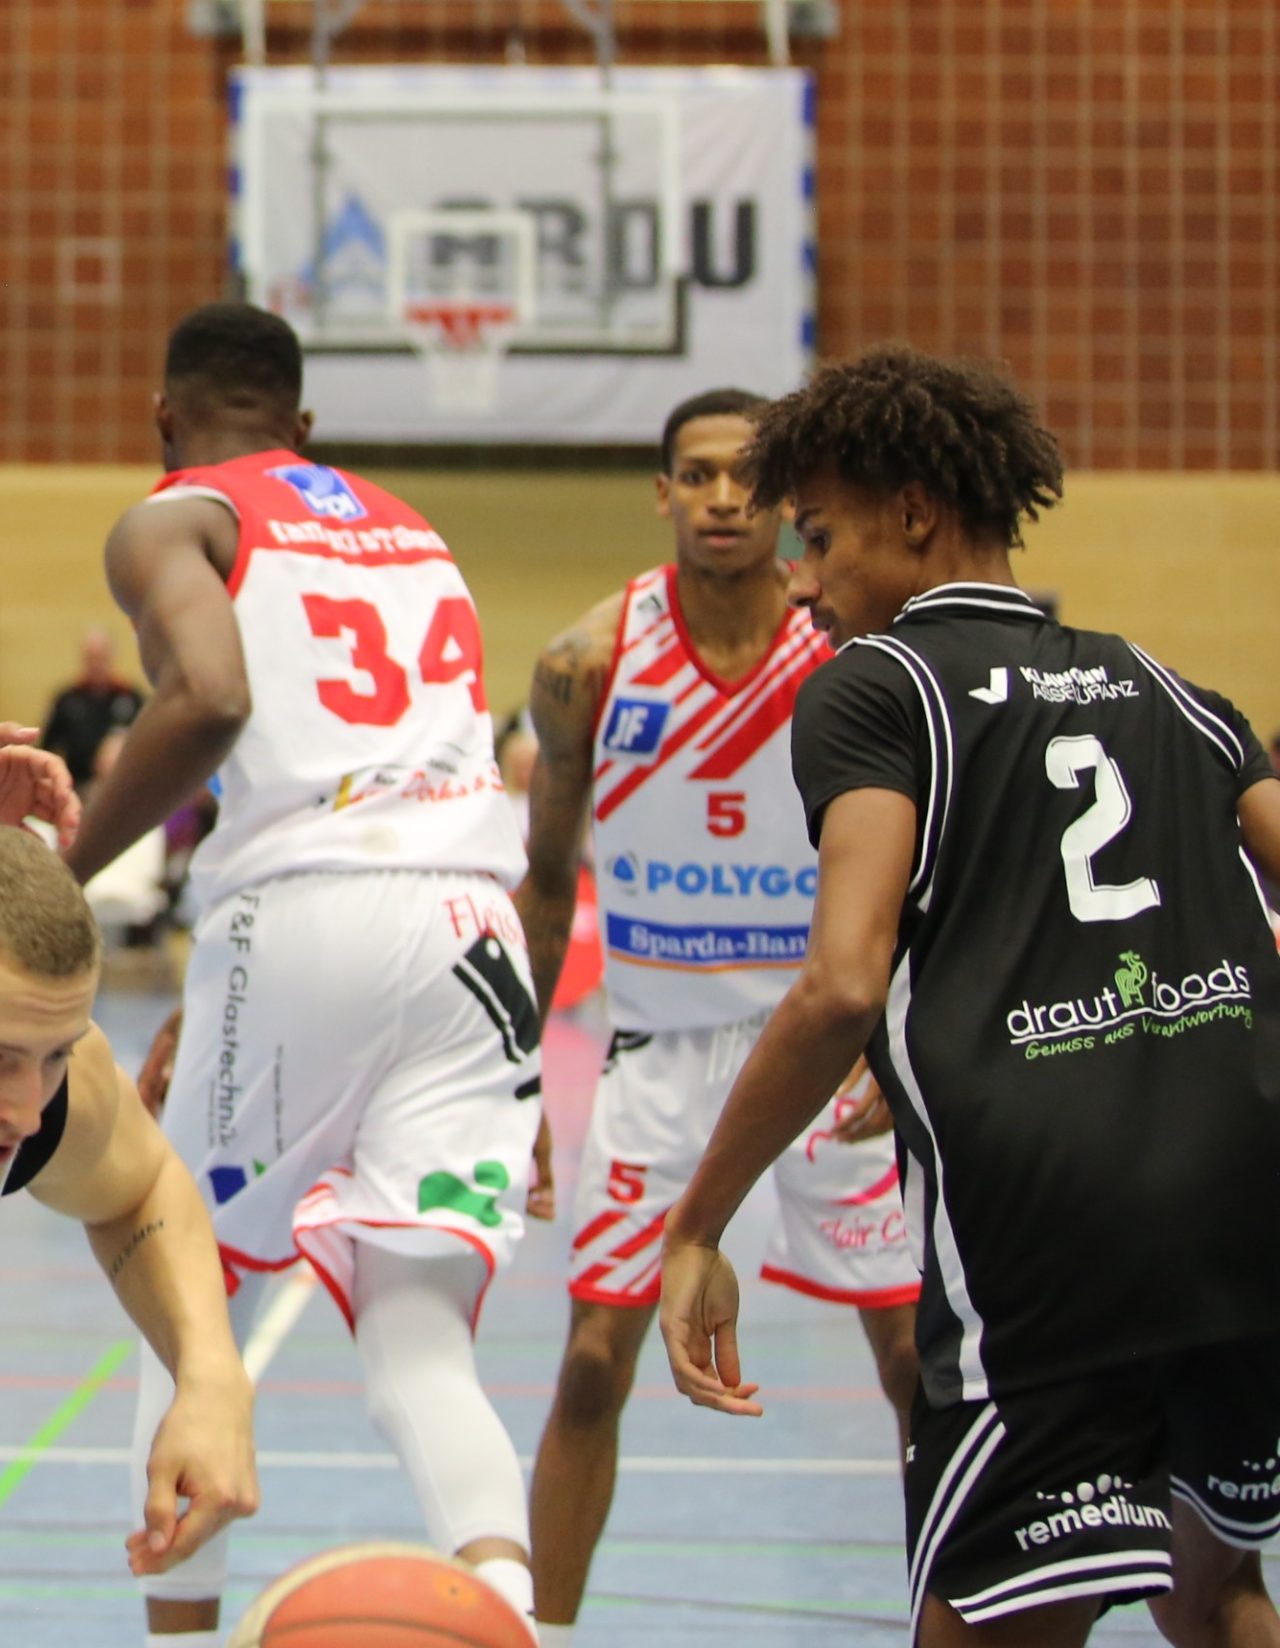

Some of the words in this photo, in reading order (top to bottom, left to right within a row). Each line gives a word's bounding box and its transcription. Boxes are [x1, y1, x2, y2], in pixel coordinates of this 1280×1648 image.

[301, 593, 489, 728] 34
[706, 791, 747, 839] 5
[1045, 734, 1162, 923] 2
[647, 860, 818, 896] POLYGO
[629, 924, 807, 958] Sparda-Ban
[1006, 987, 1120, 1037] draut
[606, 1159, 648, 1204] 5
[1014, 1495, 1173, 1551] remedium
